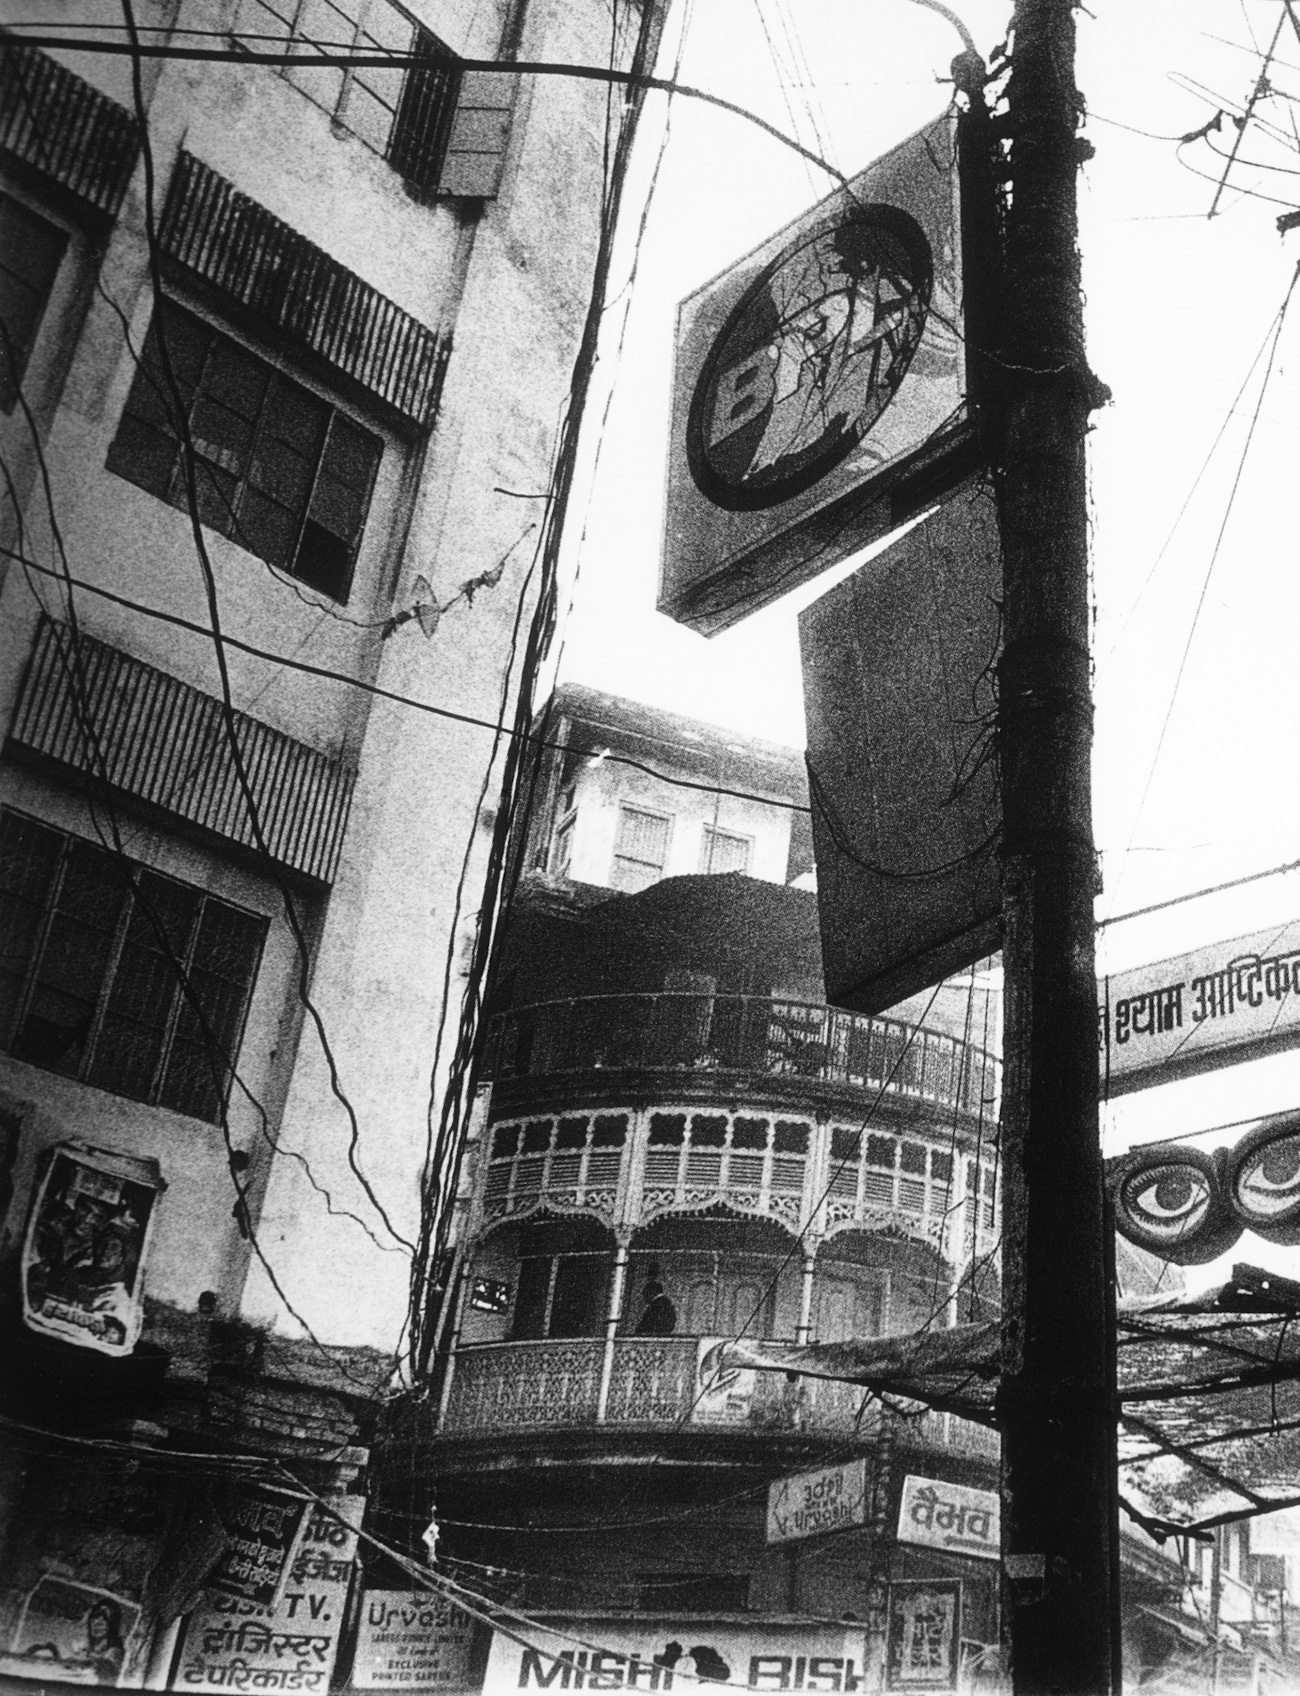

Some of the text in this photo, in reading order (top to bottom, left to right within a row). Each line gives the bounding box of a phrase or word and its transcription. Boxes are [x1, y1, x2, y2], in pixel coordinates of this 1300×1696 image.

[1116, 982, 1186, 1045] श्याम
[911, 1485, 995, 1541] वैभव
[284, 1593, 331, 1621] TV.
[368, 1601, 470, 1628] Urvashi
[202, 1620, 332, 1662] ट्रांजिस्टर
